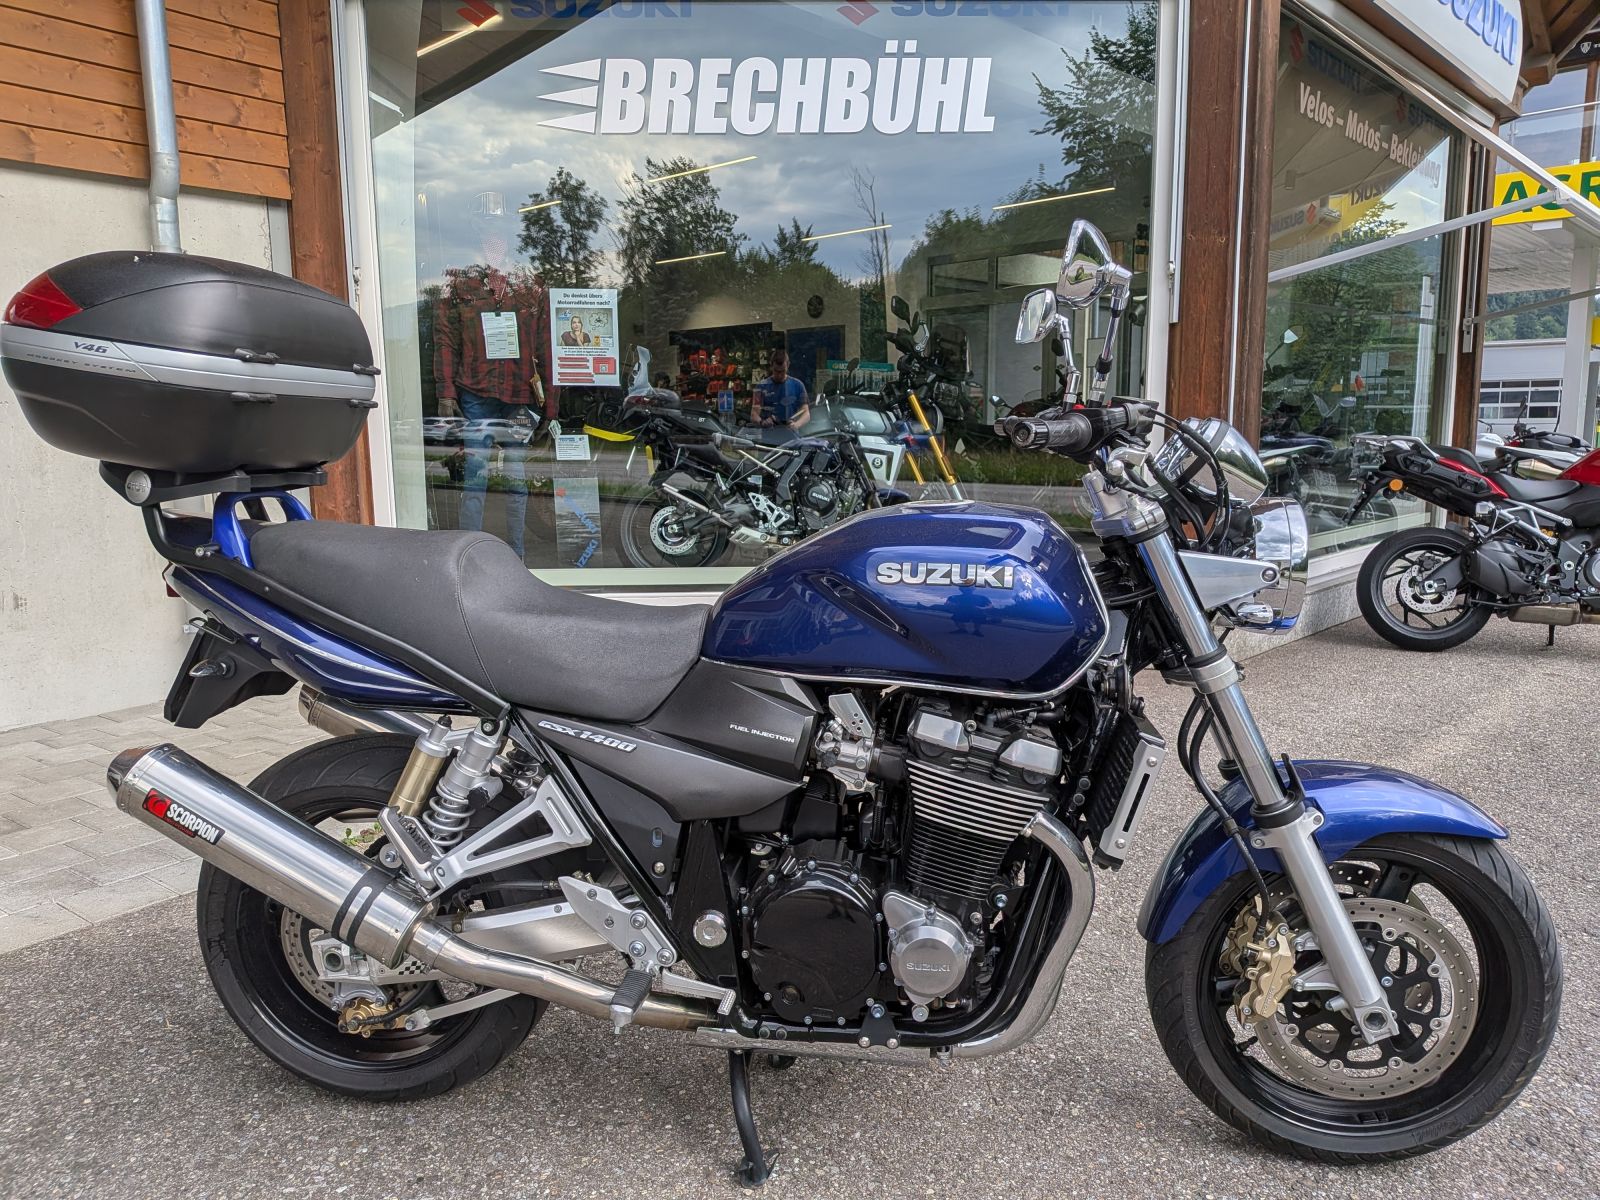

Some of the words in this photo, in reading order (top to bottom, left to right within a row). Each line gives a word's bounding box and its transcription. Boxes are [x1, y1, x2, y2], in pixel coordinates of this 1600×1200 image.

[1437, 0, 1518, 65] ZUKI
[599, 40, 995, 135] BRECHBÜHL
[1300, 82, 1335, 128] Velos
[1345, 110, 1381, 152] Motos
[74, 341, 109, 354] V46
[812, 492, 830, 502] SUZUKI
[876, 562, 1014, 588] SUZUKI
[729, 723, 750, 733] FUEL
[750, 728, 795, 743] INJECTION
[166, 803, 219, 843] SCORPION
[906, 962, 950, 972] SUZUKI
